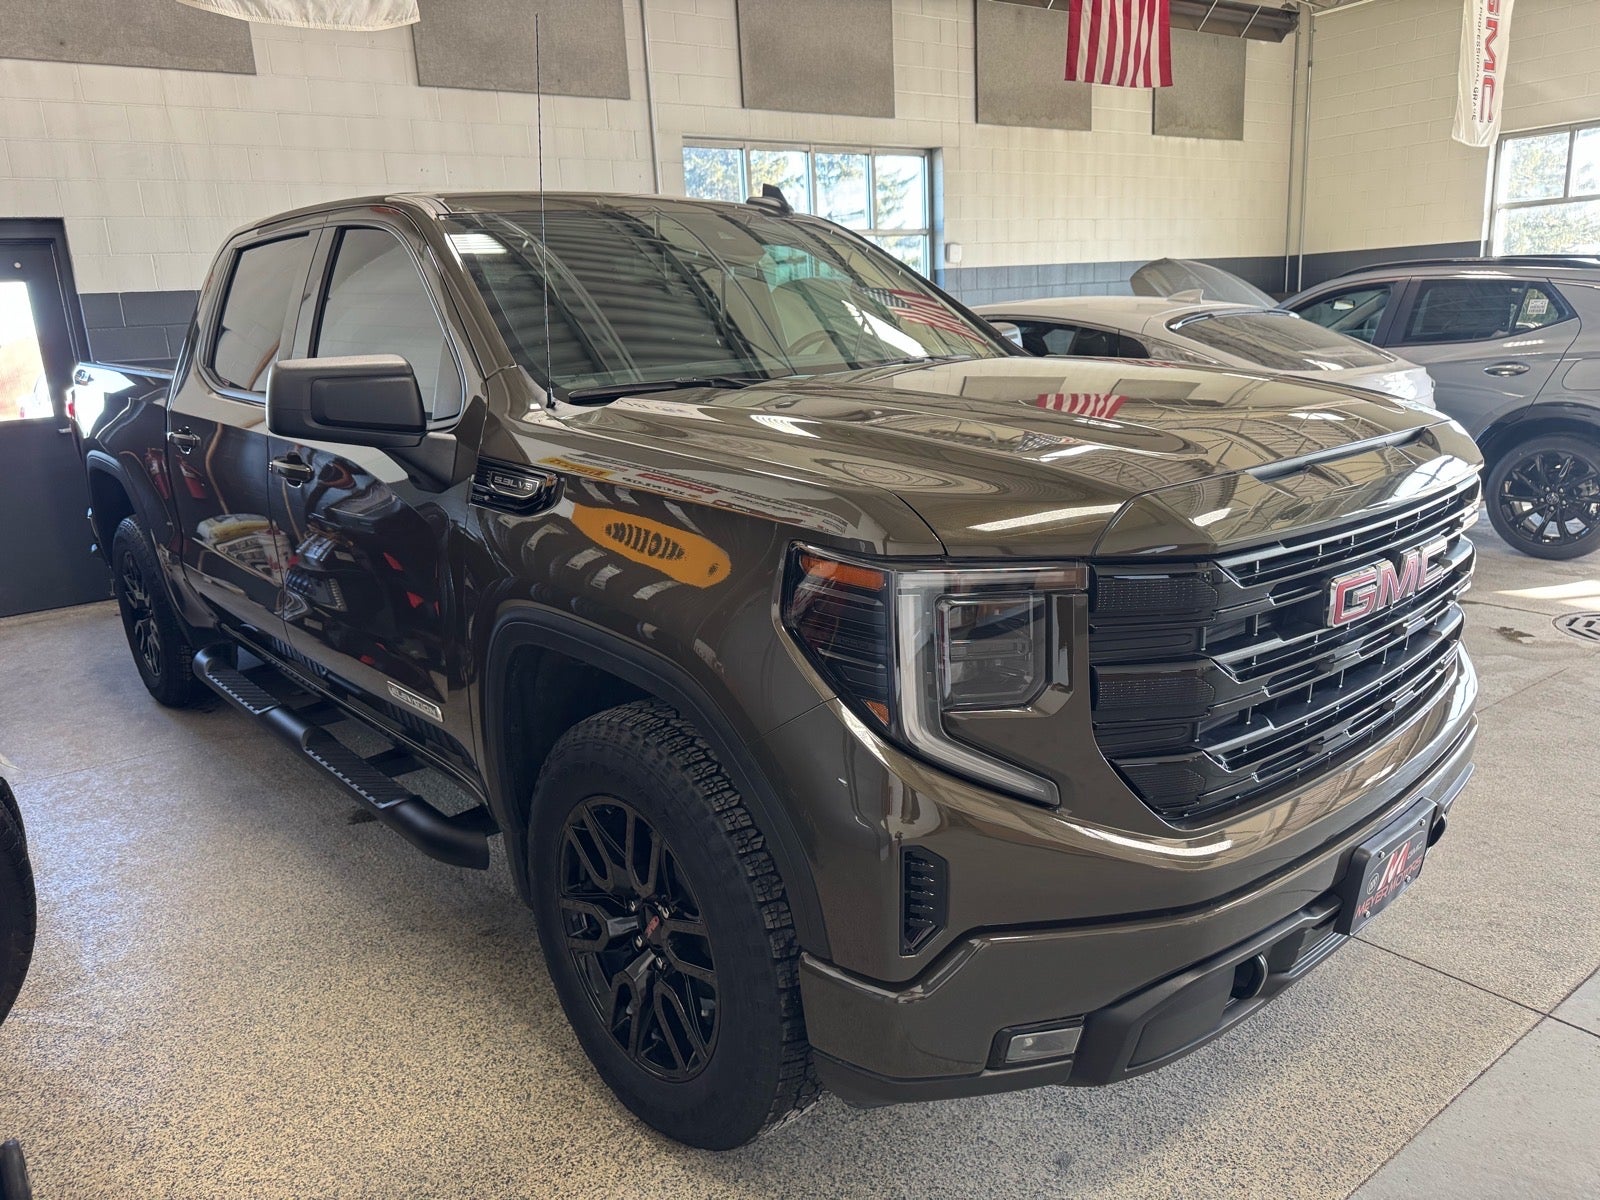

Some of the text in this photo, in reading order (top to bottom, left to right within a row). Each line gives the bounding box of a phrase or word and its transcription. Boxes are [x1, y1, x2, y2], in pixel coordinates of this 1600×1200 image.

[1327, 535, 1448, 628] GMC
[1354, 854, 1424, 919] MEYER MOTORS
